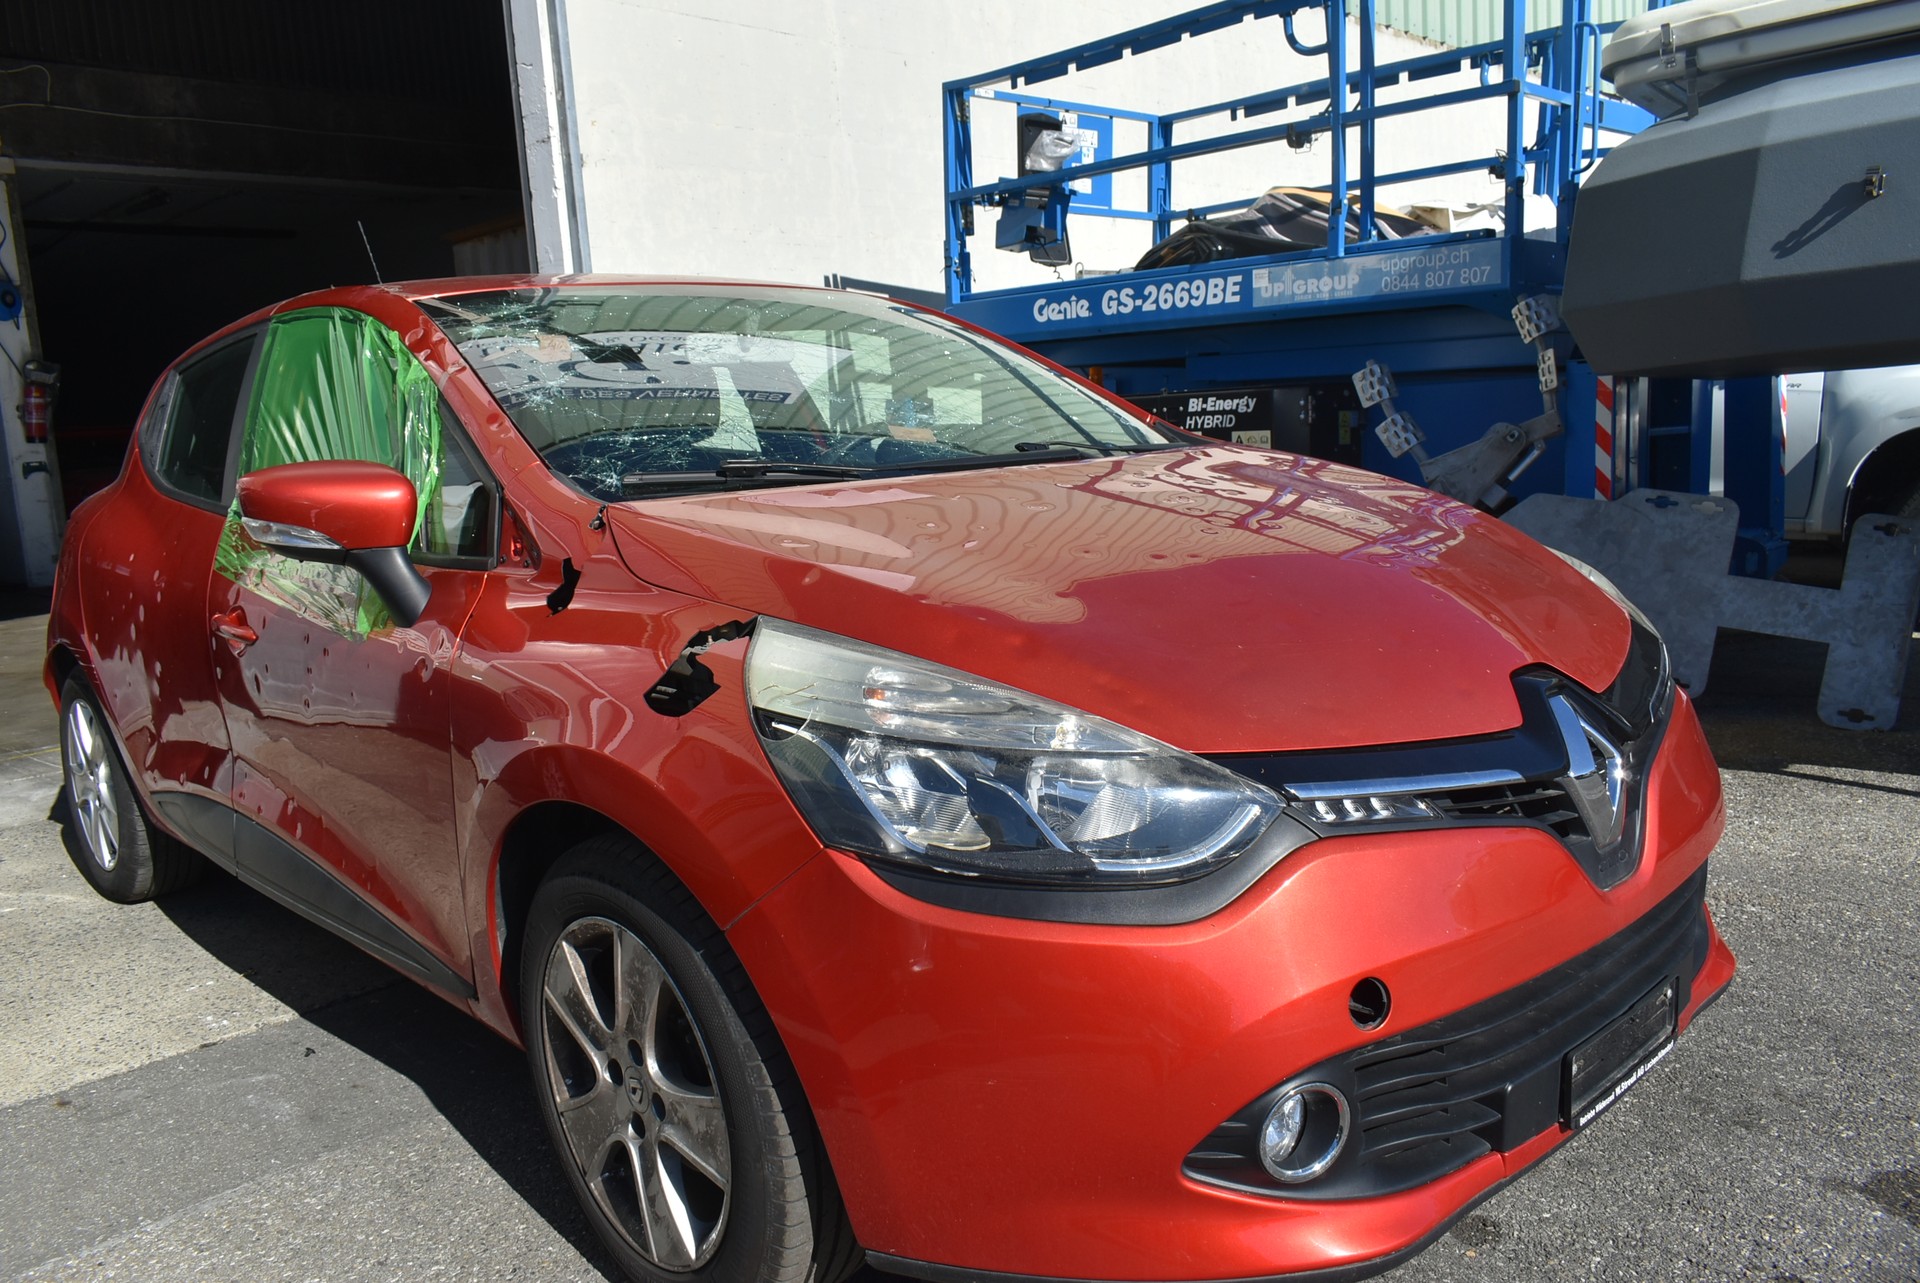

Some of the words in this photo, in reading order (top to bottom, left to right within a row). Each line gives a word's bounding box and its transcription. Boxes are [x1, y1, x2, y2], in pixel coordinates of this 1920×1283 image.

[1381, 247, 1469, 274] upgroup.ch
[1381, 273, 1419, 292] 0844
[1425, 269, 1455, 288] 807
[1460, 266, 1491, 284] 807
[1033, 295, 1091, 323] Genie
[1101, 275, 1242, 315] GS-2669BE
[1187, 395, 1257, 413] Bi-Energy
[1185, 414, 1236, 429] HYBRID
